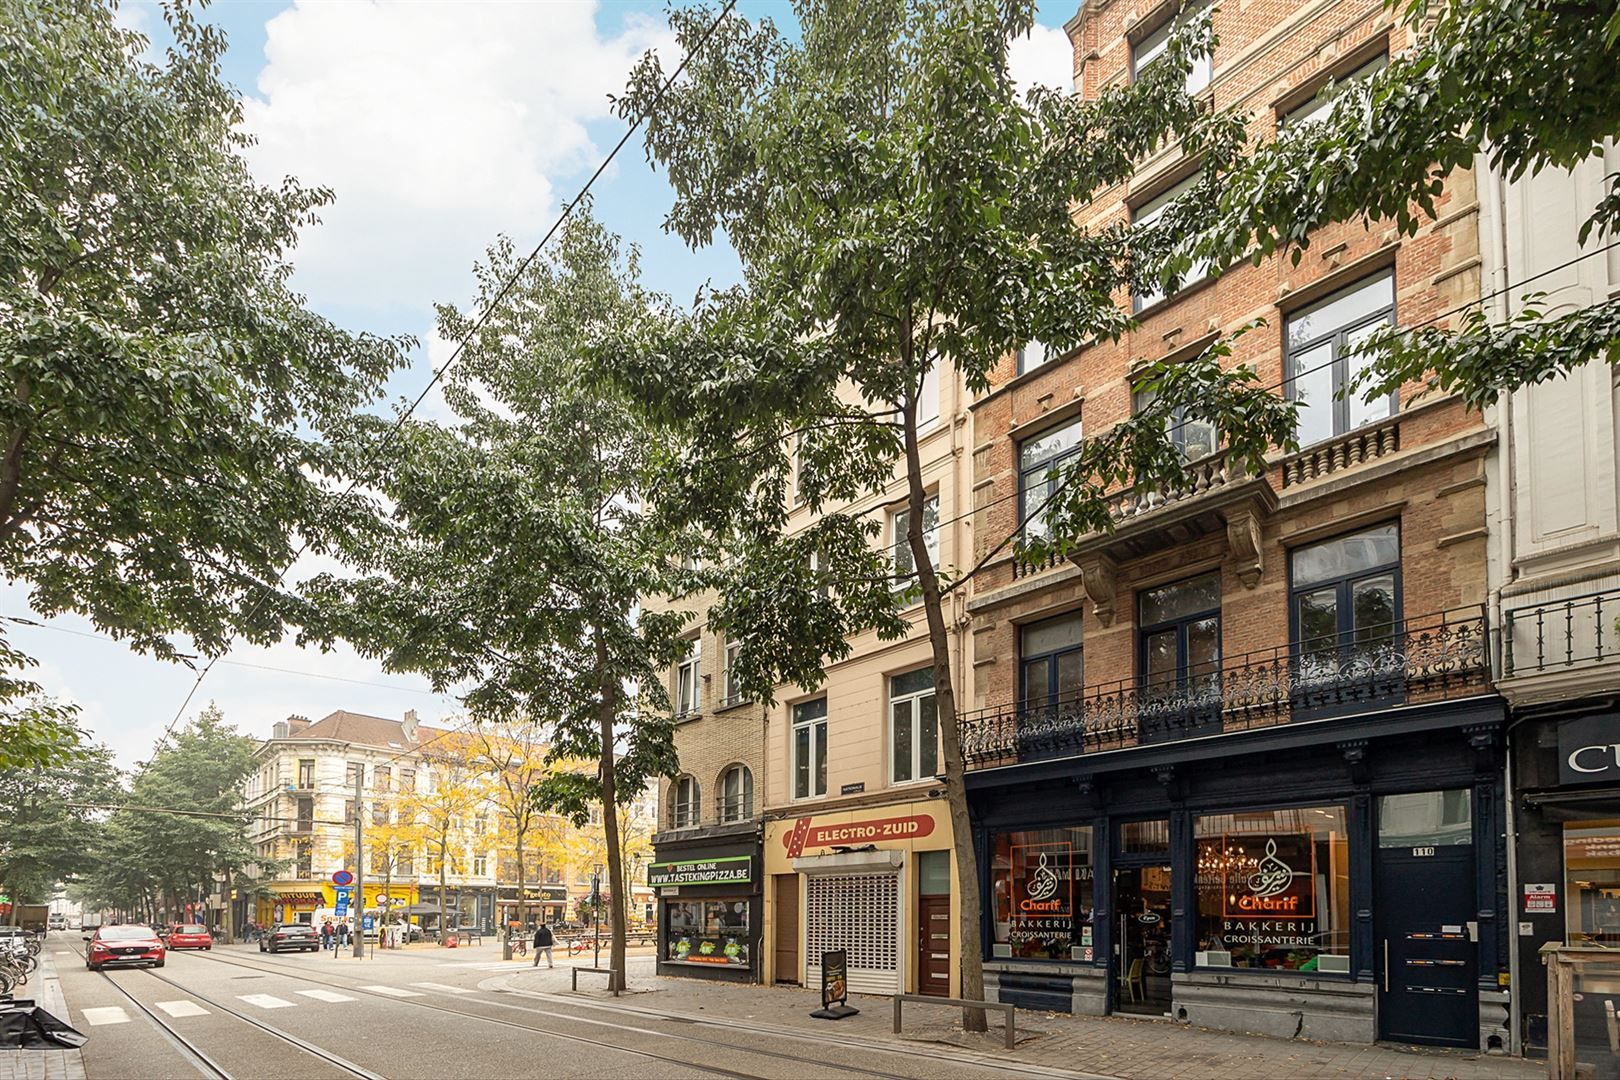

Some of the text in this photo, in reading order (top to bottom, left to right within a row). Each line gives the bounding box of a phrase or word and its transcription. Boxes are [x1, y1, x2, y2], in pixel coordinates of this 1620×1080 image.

[816, 821, 919, 842] ELECTRO-ZUID
[1414, 847, 1434, 856] 110
[676, 862, 717, 872] BESTEL ONLINE
[337, 891, 347, 901] P
[1020, 899, 1062, 911] Charif
[1238, 895, 1299, 911] Charif
[1011, 919, 1072, 929] BAKKERIJ
[1224, 921, 1314, 933] BAKKERIJ
[1011, 931, 1072, 939] CROISSANTERIE
[1224, 935, 1315, 945] CROISSANTERIE
